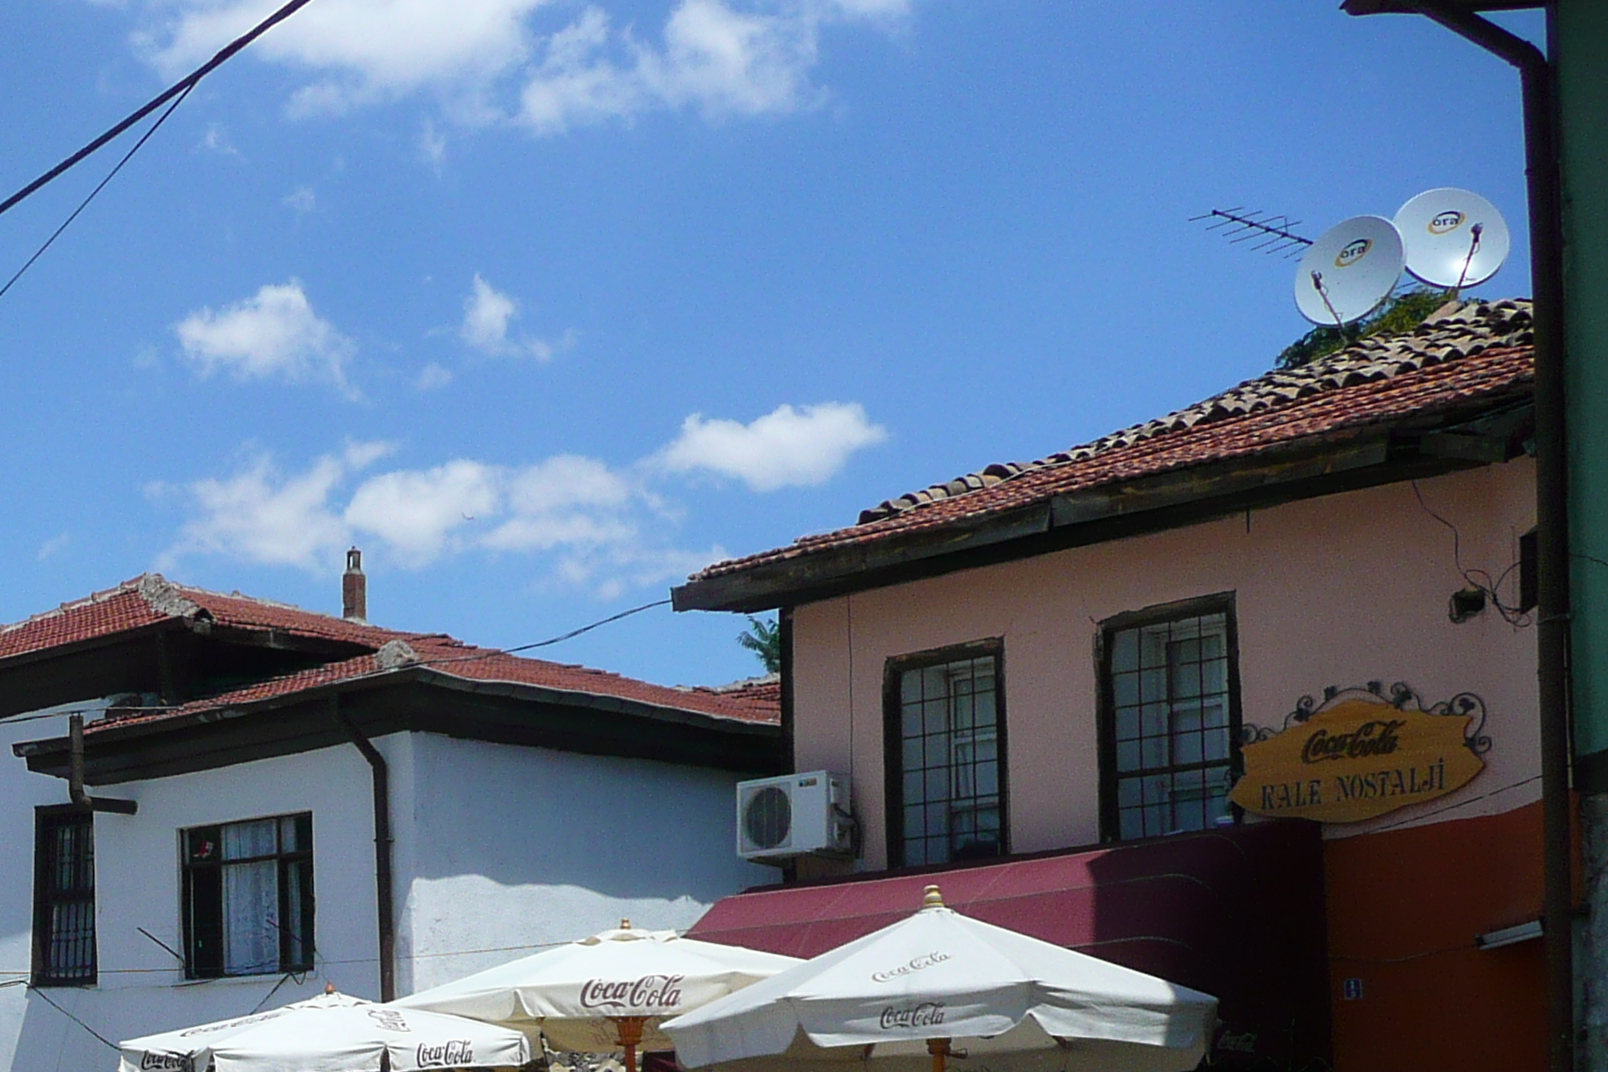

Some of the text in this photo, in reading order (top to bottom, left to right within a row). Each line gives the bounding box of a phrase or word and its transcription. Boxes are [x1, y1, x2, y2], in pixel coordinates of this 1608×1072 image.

[1432, 217, 1459, 227] ora
[1340, 245, 1366, 259] ora
[1301, 719, 1407, 764] Coca-Cola
[1261, 758, 1446, 810] KALE NOSTALJİ
[580, 974, 685, 1009] Coca-Cola
[880, 1002, 945, 1029] Coca-Cola
[416, 1040, 473, 1068] Coca-Cola
